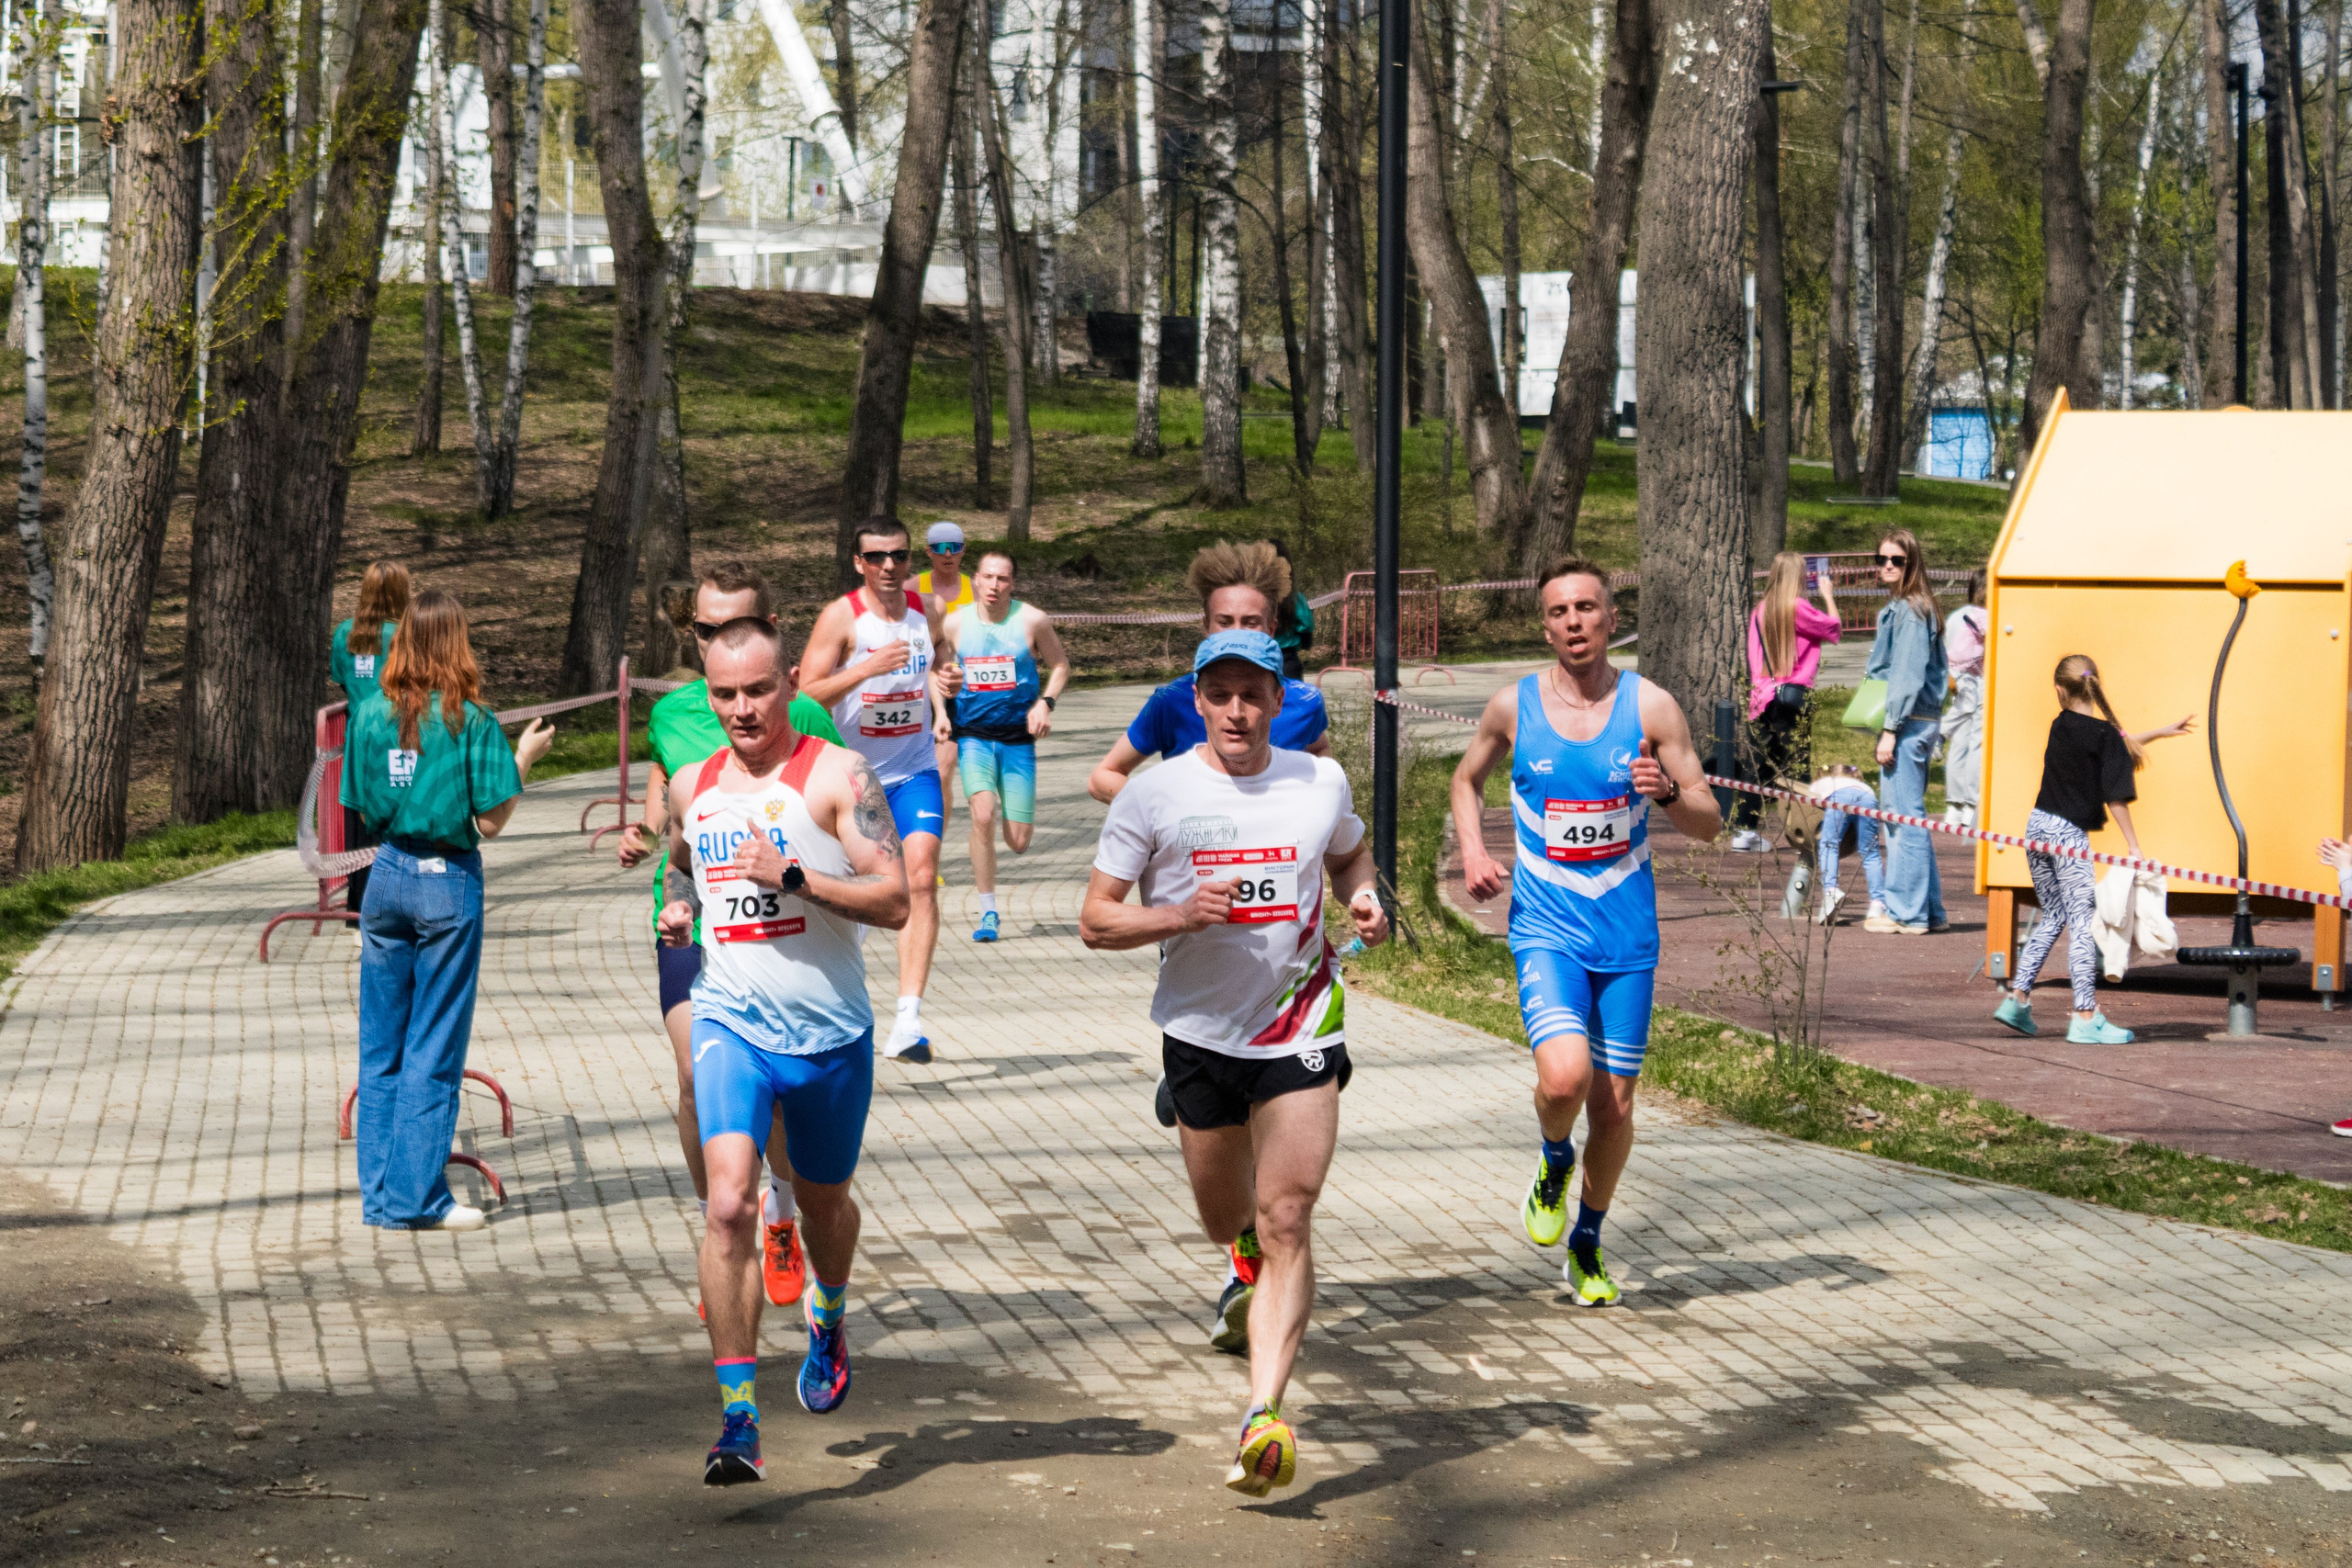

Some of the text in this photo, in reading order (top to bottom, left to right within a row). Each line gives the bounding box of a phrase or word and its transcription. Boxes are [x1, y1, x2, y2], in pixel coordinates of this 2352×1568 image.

[974, 671, 1008, 682] 1073
[875, 710, 911, 726] 342
[1176, 826, 1238, 847] ЛУЖНИКИ
[1563, 823, 1614, 844] 494
[726, 893, 780, 920] 703
